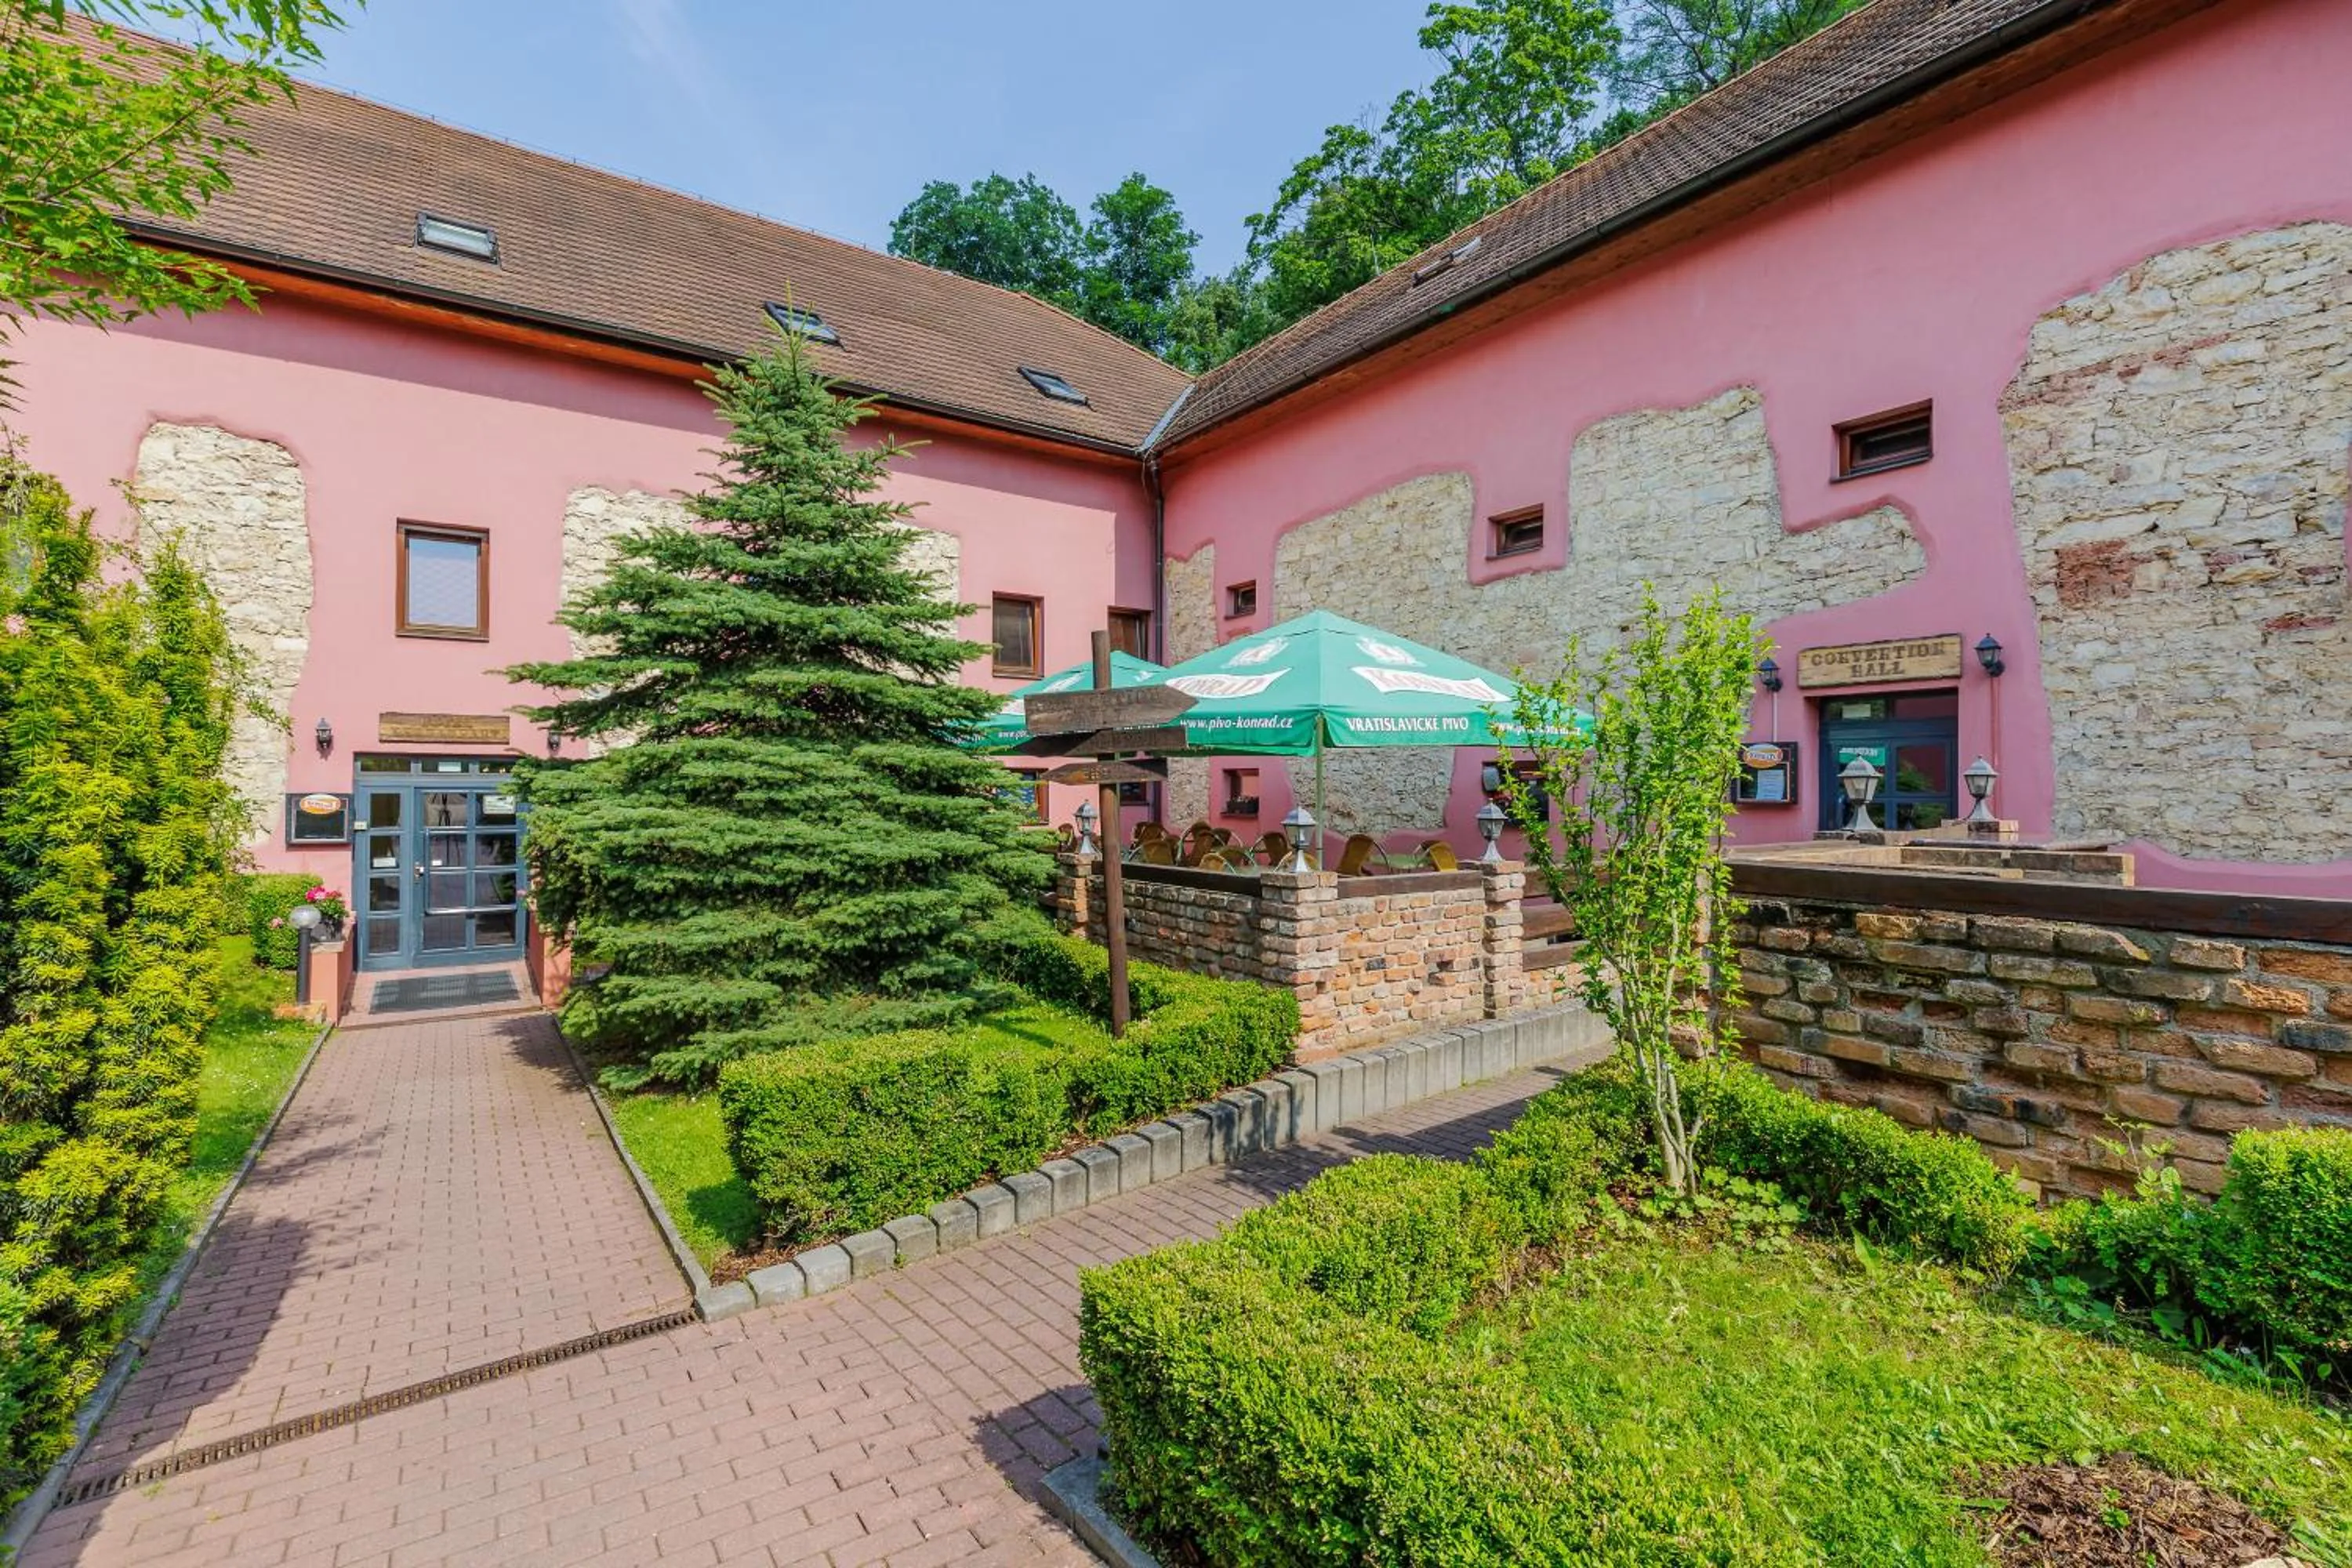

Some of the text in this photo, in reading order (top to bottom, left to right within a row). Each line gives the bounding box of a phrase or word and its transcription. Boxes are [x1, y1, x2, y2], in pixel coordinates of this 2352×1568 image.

[1811, 641, 1945, 666] CONVENTION
[1851, 662, 1905, 677] HALL
[1179, 714, 1294, 734] www.pivo-konrad.cz
[1345, 713, 1468, 732] VRATISLAVICKÉ PIVO
